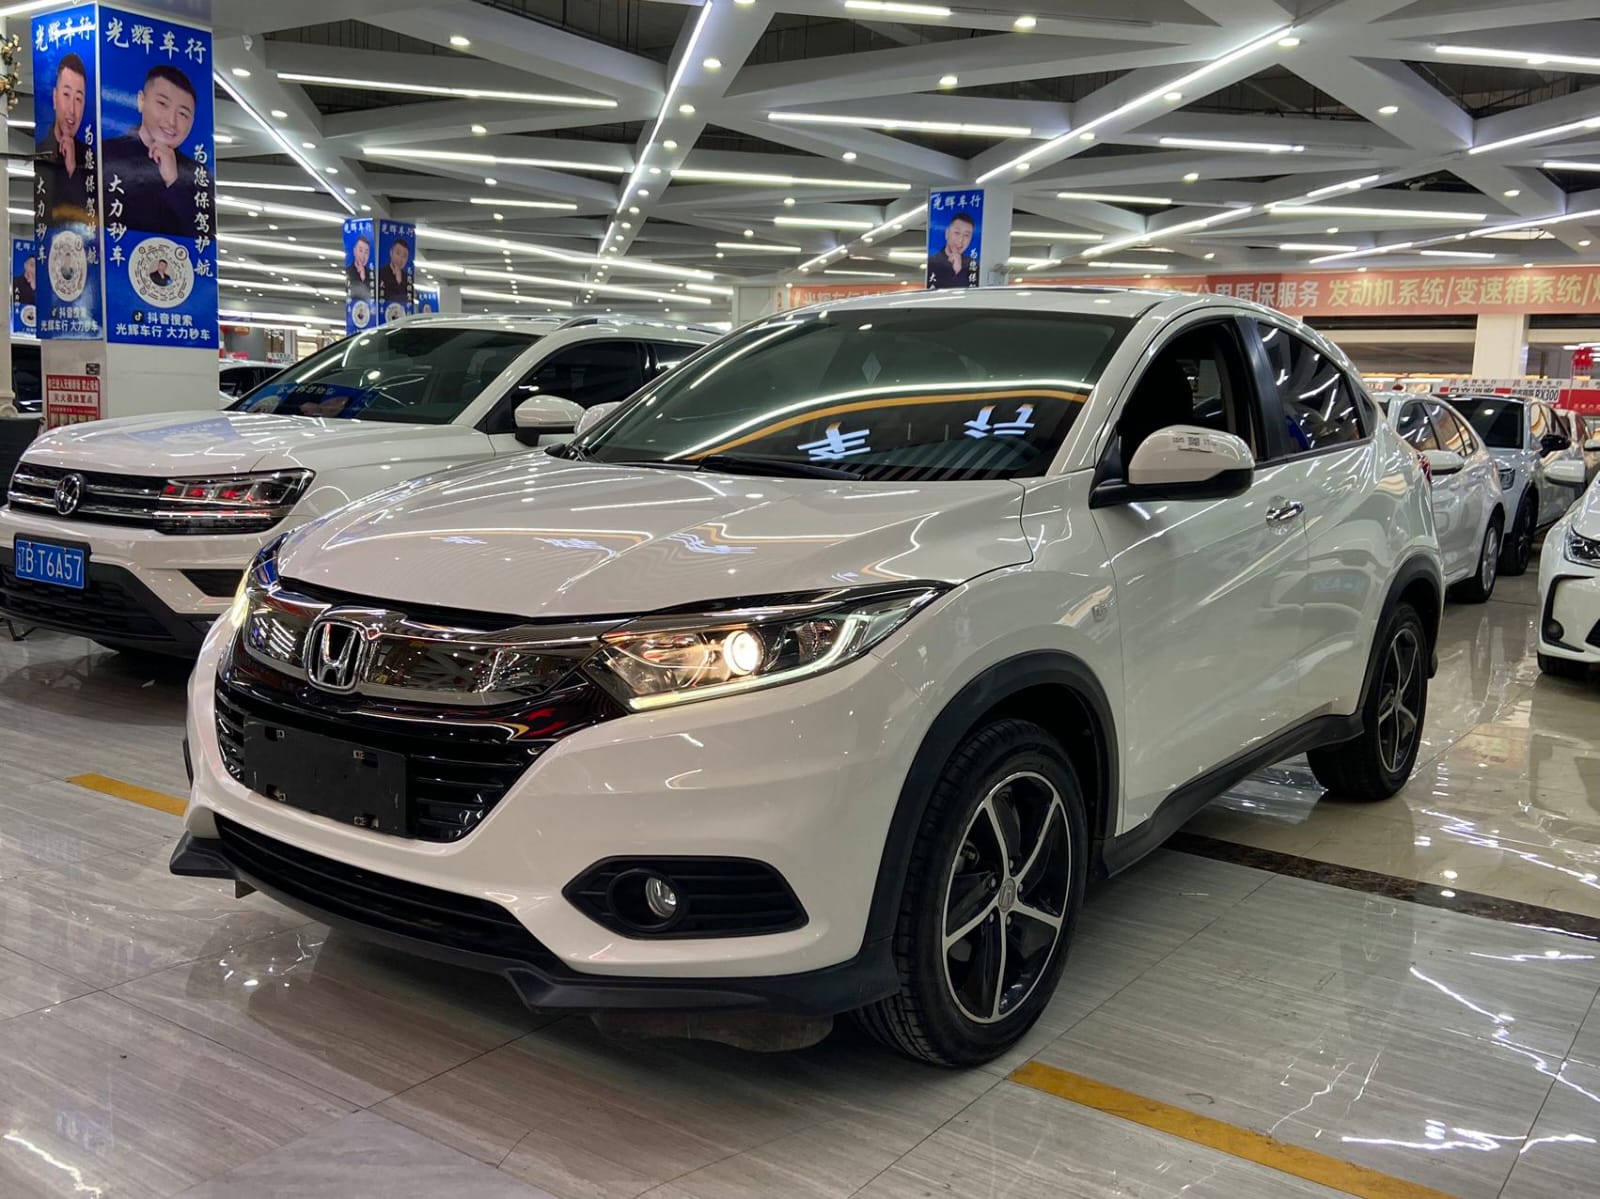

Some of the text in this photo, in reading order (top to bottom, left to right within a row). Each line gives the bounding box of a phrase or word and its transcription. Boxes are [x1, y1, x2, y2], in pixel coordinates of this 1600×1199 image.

[105, 17, 207, 64] 光辉车行
[36, 176, 48, 265] 大力秒车
[107, 174, 127, 268] 大力秒车
[194, 143, 214, 278] 为您保驾护航
[933, 194, 981, 210] 光辉车行
[116, 323, 211, 341] 光辉车行 大力秒车
[147, 311, 194, 327] 抖音搜索
